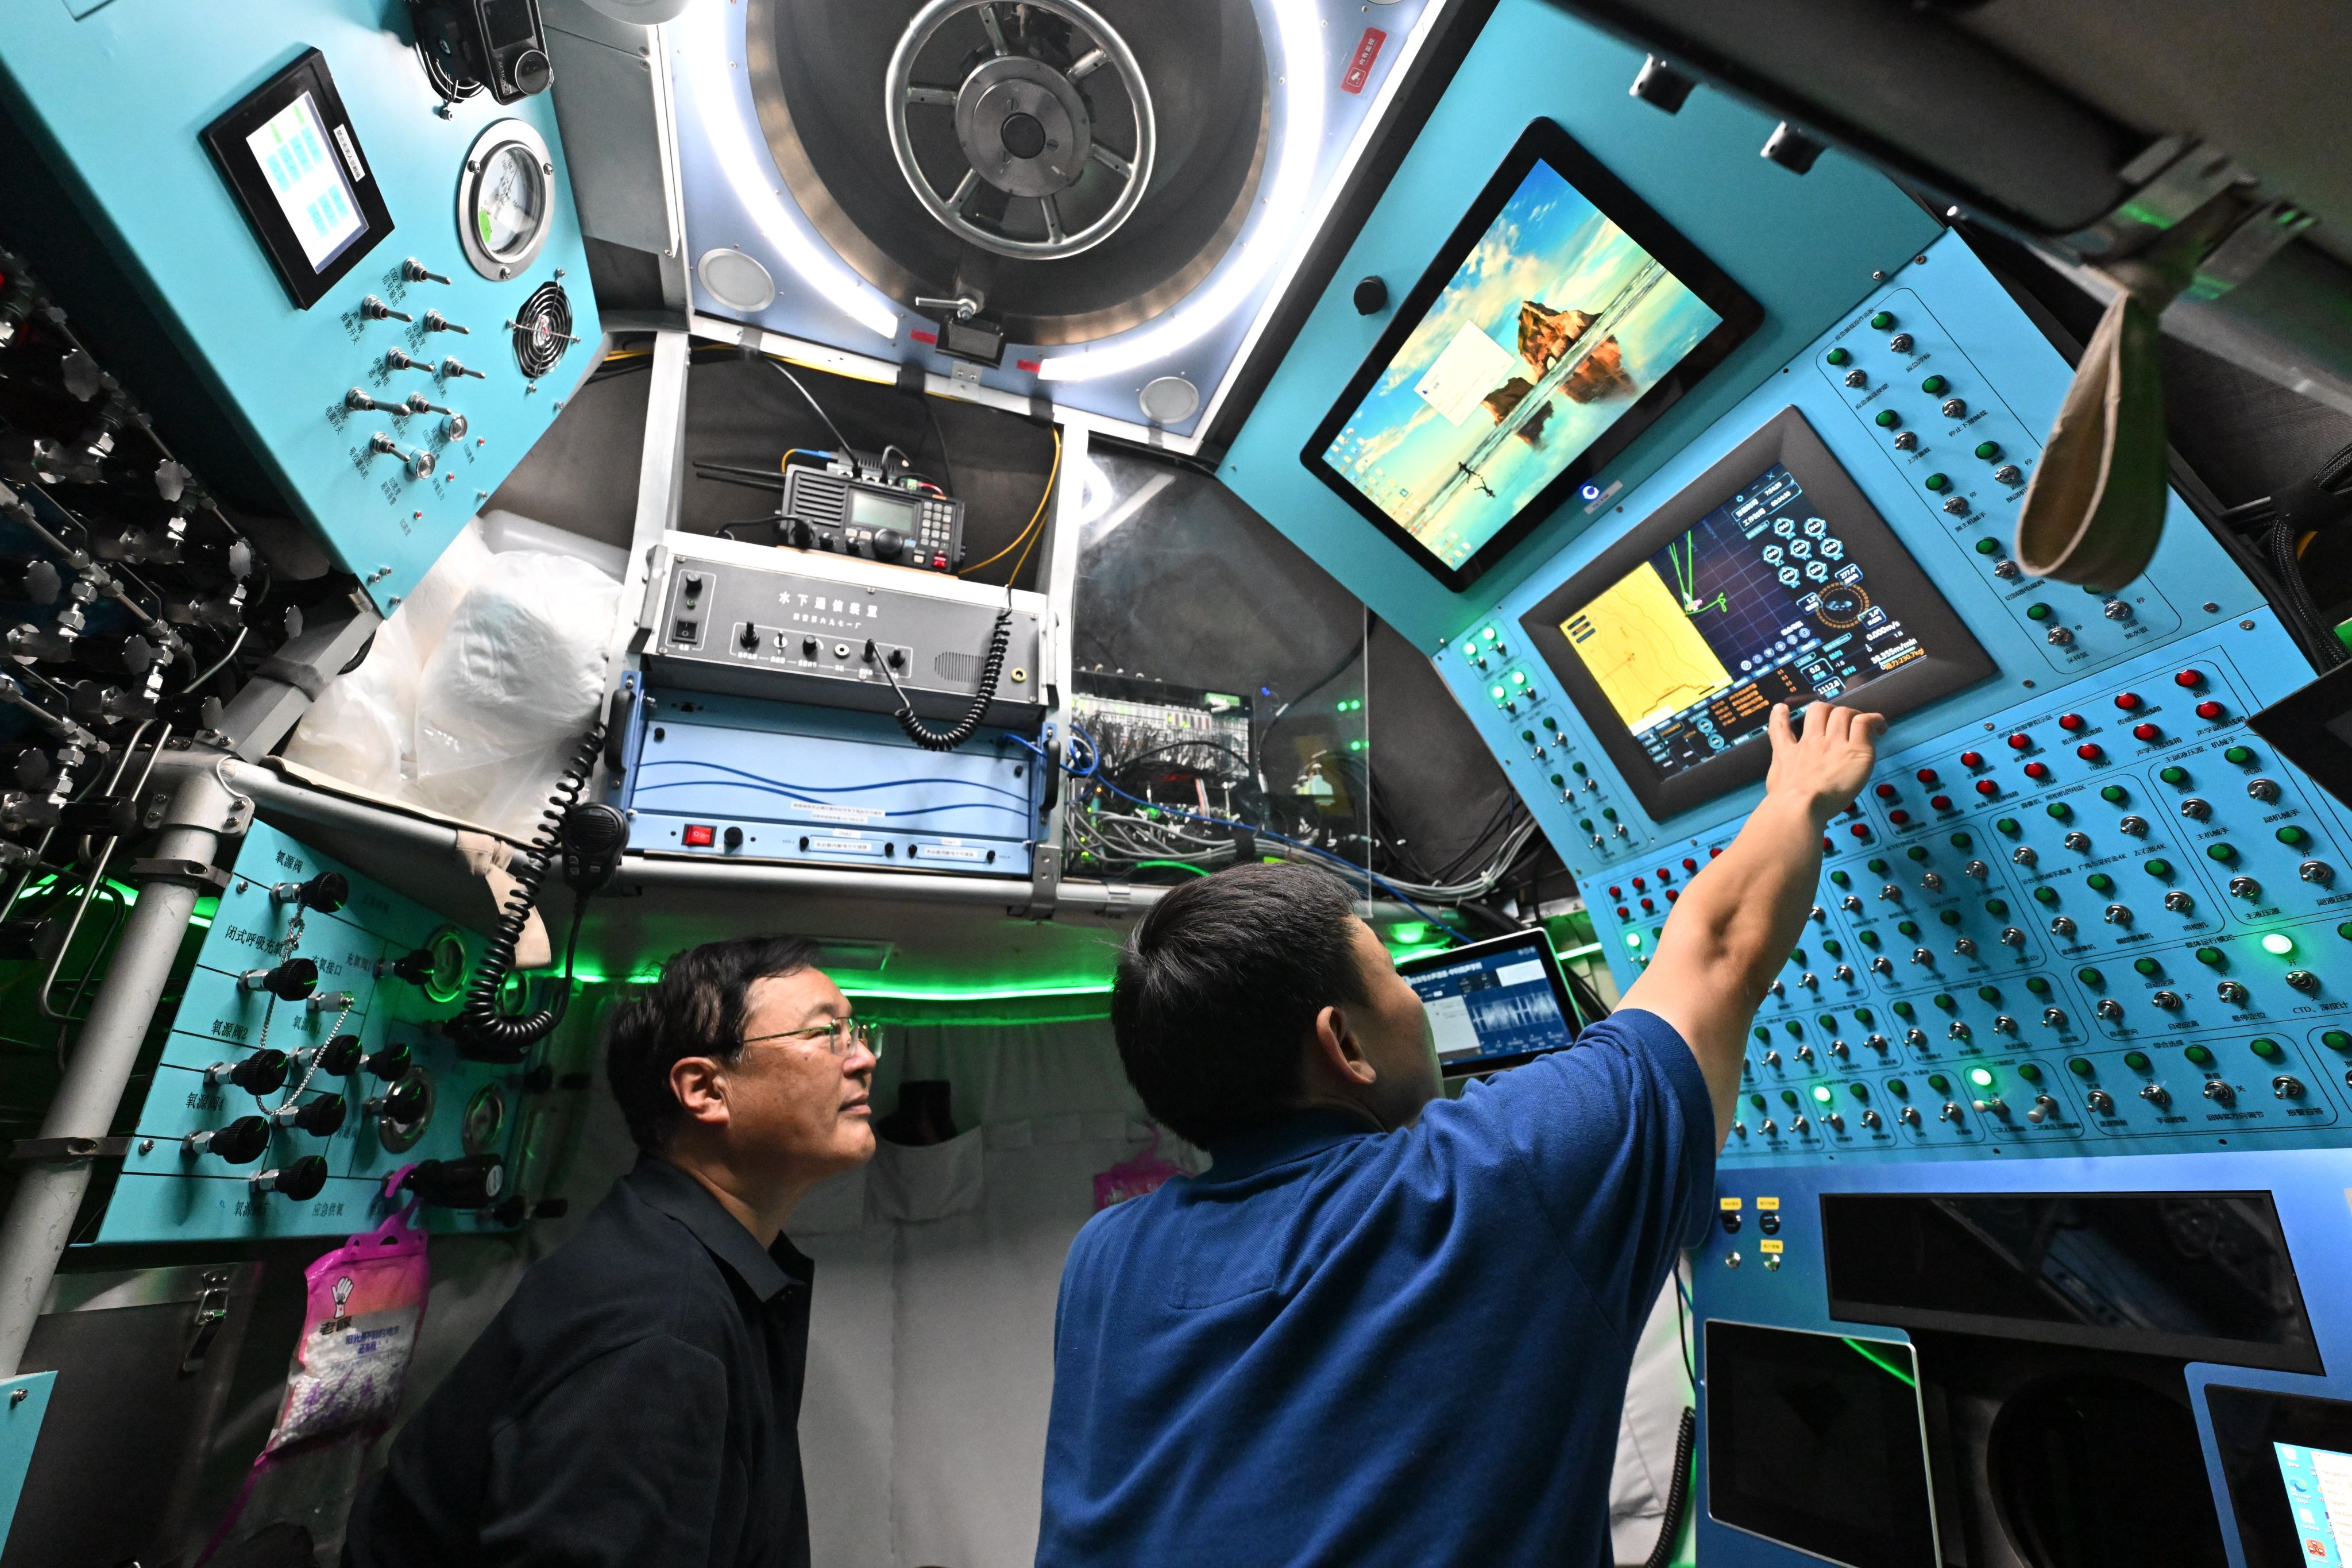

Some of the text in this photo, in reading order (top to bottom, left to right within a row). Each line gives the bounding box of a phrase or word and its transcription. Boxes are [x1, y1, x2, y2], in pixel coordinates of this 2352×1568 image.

[1359, 38, 1374, 65] 内有监控
[381, 275, 400, 307] 信号输出
[340, 312, 361, 345] 报警开关
[404, 327, 420, 356] 信号输出
[1906, 352, 1932, 373] 应急浮标
[334, 402, 349, 423] 24VDC
[325, 405, 344, 435] 电源开关
[1949, 410, 1988, 437] 停止下潜抛载
[1907, 446, 1932, 465] 上浮抛载
[348, 446, 369, 480] 吸收罐风机
[2011, 479, 2026, 491] 返回
[1959, 509, 1973, 520] 返回
[1955, 511, 1987, 532] 抛主机械手
[2010, 576, 2026, 586] 返回
[2005, 579, 2045, 601] 切割器电磁阀
[778, 591, 878, 618] 水下通信装置
[1866, 620, 1901, 641] 0.000m/s
[2121, 619, 2139, 629] 返回
[2125, 627, 2149, 640] 抛水银
[2064, 644, 2080, 655] 返回
[1809, 665, 1821, 673] 0.0
[2192, 688, 2211, 699] 备用
[2117, 705, 2163, 725] 传感器接线箱
[2196, 716, 2246, 737] 声学副接线箱
[2061, 727, 2104, 746] 备用蓄电池箱
[2135, 737, 2183, 756] 声学主接线箱
[2088, 760, 2112, 772] 10LPM
[2243, 767, 2263, 777] 供油
[2035, 779, 2058, 789] 15LPM
[2177, 786, 2196, 795] 供油
[2262, 809, 2300, 824] 副机械手
[2196, 827, 2230, 840] 主机械手
[2133, 843, 2167, 856] 左右舷4K
[2300, 849, 2311, 858] 开
[275, 849, 303, 874] 氧源阀
[2243, 907, 2281, 920] 主液压源
[2183, 921, 2209, 932] 照相机
[2185, 934, 2235, 948] 载体运行模式
[2287, 959, 2297, 967] 开
[2144, 979, 2176, 989] 自动定深
[2231, 1012, 2268, 1022] 悬停定位
[211, 1019, 248, 1040] 氧源阀2
[2168, 1020, 2200, 1030] 自动定高
[2153, 1040, 2185, 1049] 综合选择
[186, 1092, 225, 1112] 氧源阀4
[2206, 1111, 2265, 1121] 回转桨方向调节
[2287, 1107, 2324, 1117] 报警应答
[2156, 1116, 2188, 1124] 手动控制
[312, 1202, 344, 1217] 应急供氧
